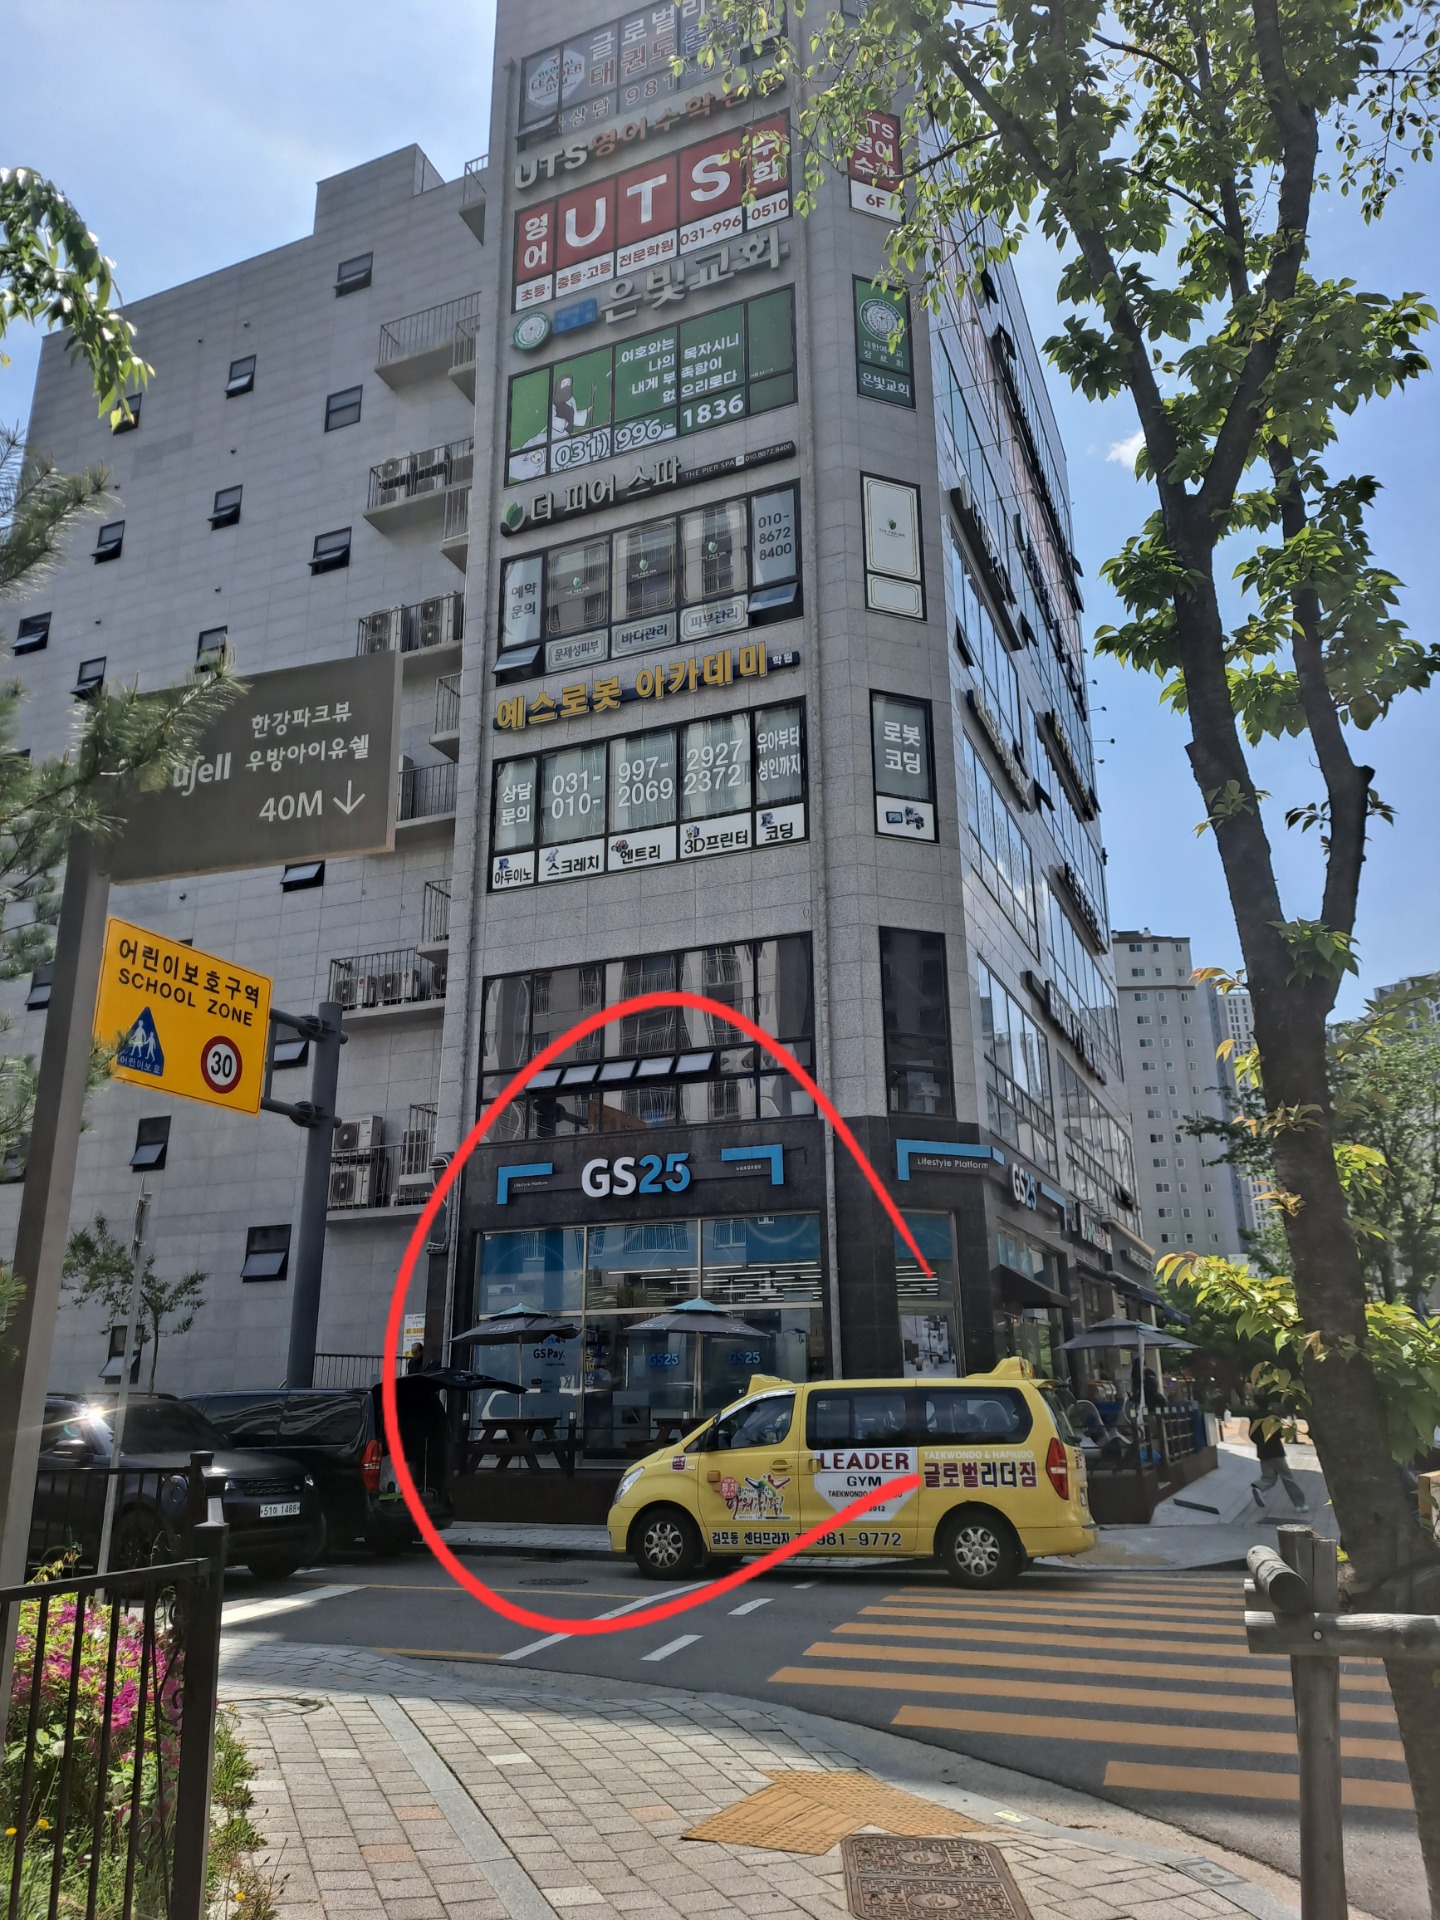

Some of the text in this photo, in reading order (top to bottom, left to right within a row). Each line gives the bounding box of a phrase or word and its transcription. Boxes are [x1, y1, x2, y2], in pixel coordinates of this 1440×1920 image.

[565, 154, 732, 248] UTS
[866, 194, 885, 208] 6F
[619, 238, 675, 268] 전문학원
[600, 225, 790, 324] 은빛교회
[621, 338, 674, 363] 여호와는
[649, 333, 739, 372] 나의 목자시니
[631, 375, 658, 395] 내게
[861, 372, 909, 398] 은빛교회
[530, 491, 552, 520] 더
[626, 455, 681, 496] 스파
[759, 527, 791, 545] 8672
[759, 543, 792, 560] 8400
[511, 582, 537, 599] 예약
[511, 602, 536, 620] 문의
[555, 607, 738, 661] 문제성피부 바디관리 피부관리
[497, 641, 793, 730] 예스로봇 아카데미 학원
[251, 701, 352, 739] 한강파크뷰
[884, 721, 921, 747] 로봇
[245, 734, 369, 772] 우방아이유쉘
[502, 782, 532, 804] 상담
[757, 726, 800, 751] 유아부터
[884, 750, 922, 775] 코딩
[258, 790, 323, 823] 40M
[501, 803, 531, 826] 문의
[495, 821, 793, 886] 아두이노 스크레치 엔트리 3D프린터 코딩
[119, 939, 259, 1009] 어린이보호구역
[119, 967, 253, 1027] SCHOOL ZONE
[211, 1051, 233, 1078] 30
[581, 1152, 691, 1198] GS25
[917, 1157, 952, 1168] Lifestyle
[954, 1159, 989, 1170] Platform
[820, 1452, 909, 1470] LEADER
[924, 1451, 982, 1460] TAEKWONDO
[992, 1450, 1034, 1459] HAPKIDO
[846, 1475, 882, 1487] GYM
[923, 1461, 1038, 1488] 글로벌리더짐
[712, 1532, 738, 1545] 걸포동
[744, 1532, 791, 1545] 센터프라자
[816, 1532, 902, 1546] 981-9772
